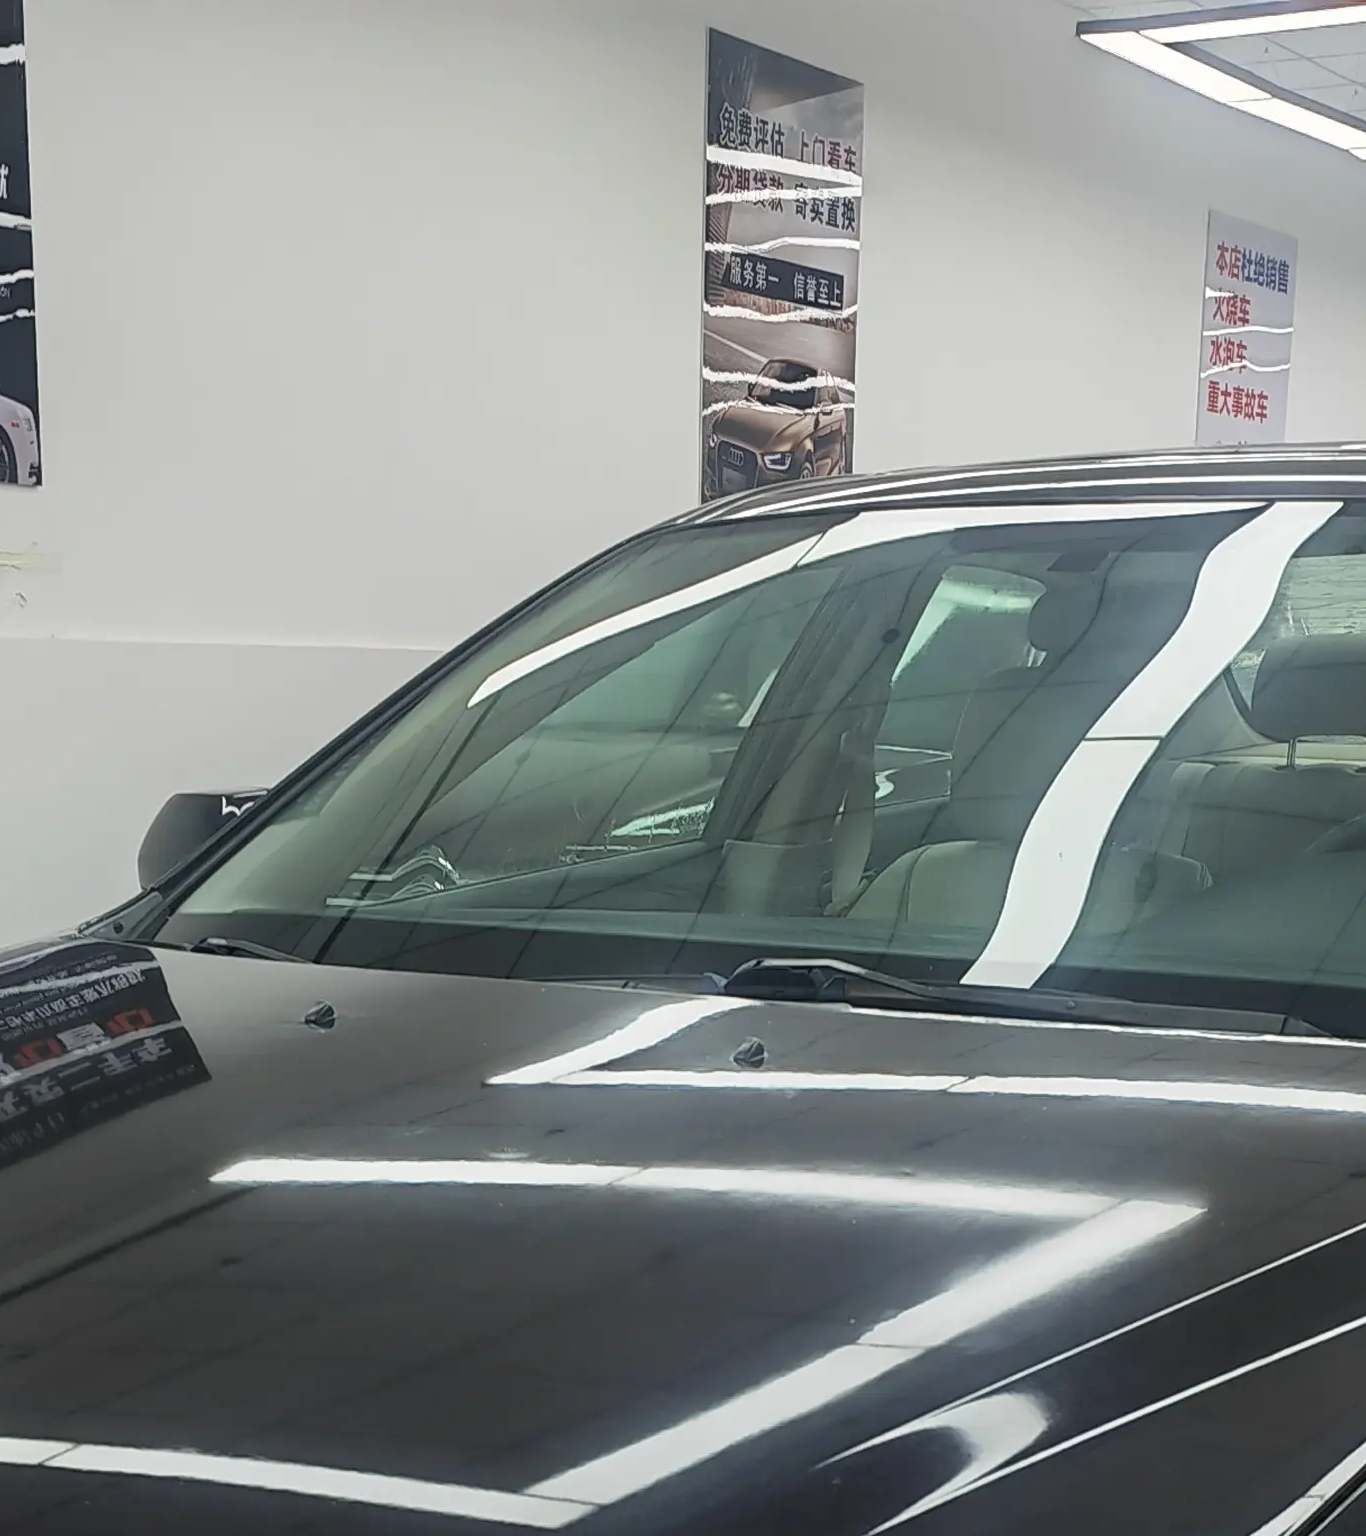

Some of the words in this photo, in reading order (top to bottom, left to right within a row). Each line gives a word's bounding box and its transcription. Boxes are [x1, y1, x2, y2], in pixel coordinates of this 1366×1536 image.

[720, 102, 785, 158] 免费评估
[798, 129, 858, 174] 上门看车
[729, 255, 780, 292] 服务第一
[792, 271, 842, 308] 信誉至上
[1215, 240, 1290, 296] 本店杜绝销售
[1212, 288, 1252, 328] 火烧车
[1209, 335, 1248, 375] 水泡车
[1206, 379, 1269, 424] 重大事故车
